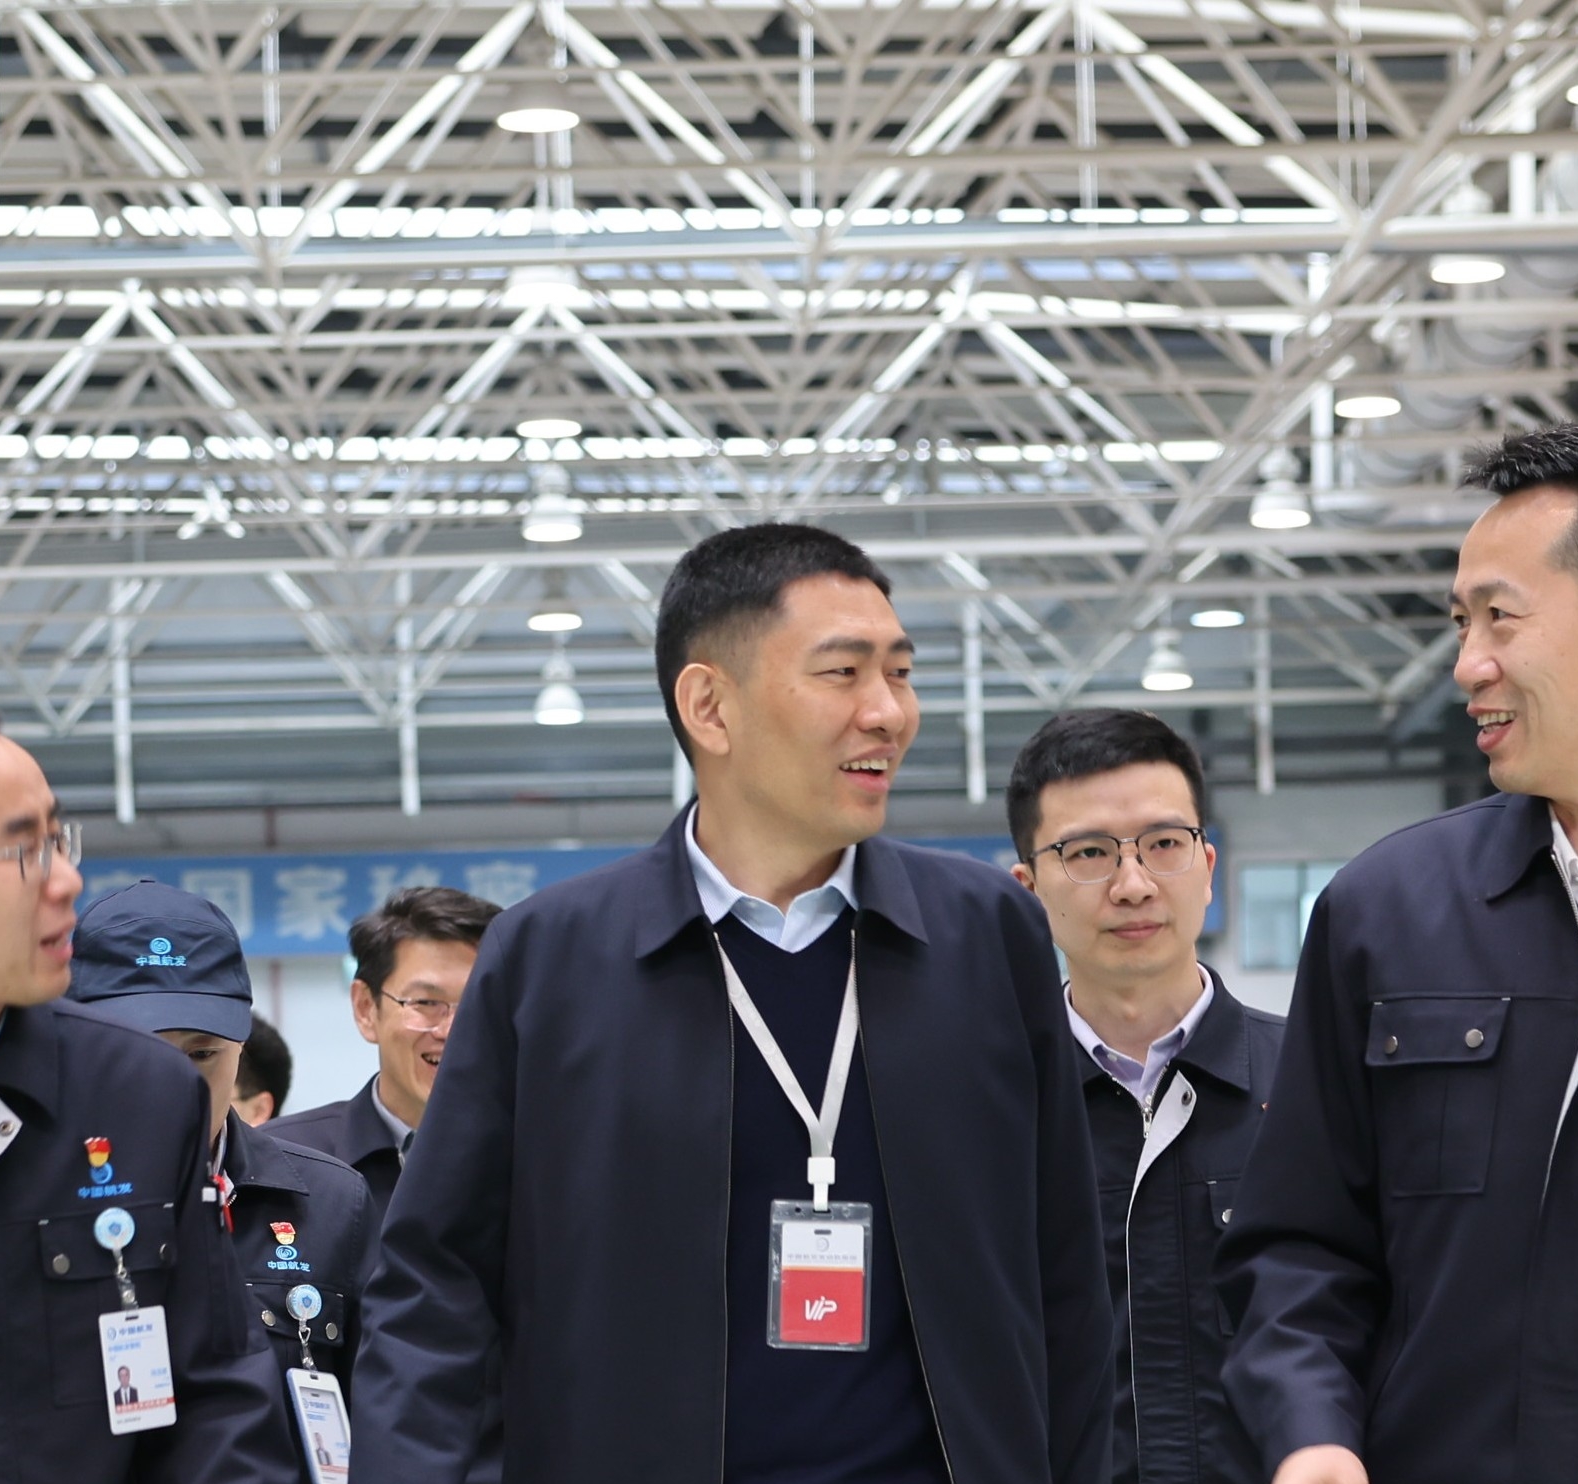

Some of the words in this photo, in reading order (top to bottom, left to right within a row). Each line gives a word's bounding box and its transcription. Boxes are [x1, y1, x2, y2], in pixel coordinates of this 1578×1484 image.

[135, 954, 187, 967] 中国航发
[77, 1182, 133, 1199] 中国航发
[267, 1260, 311, 1273] 中国航发
